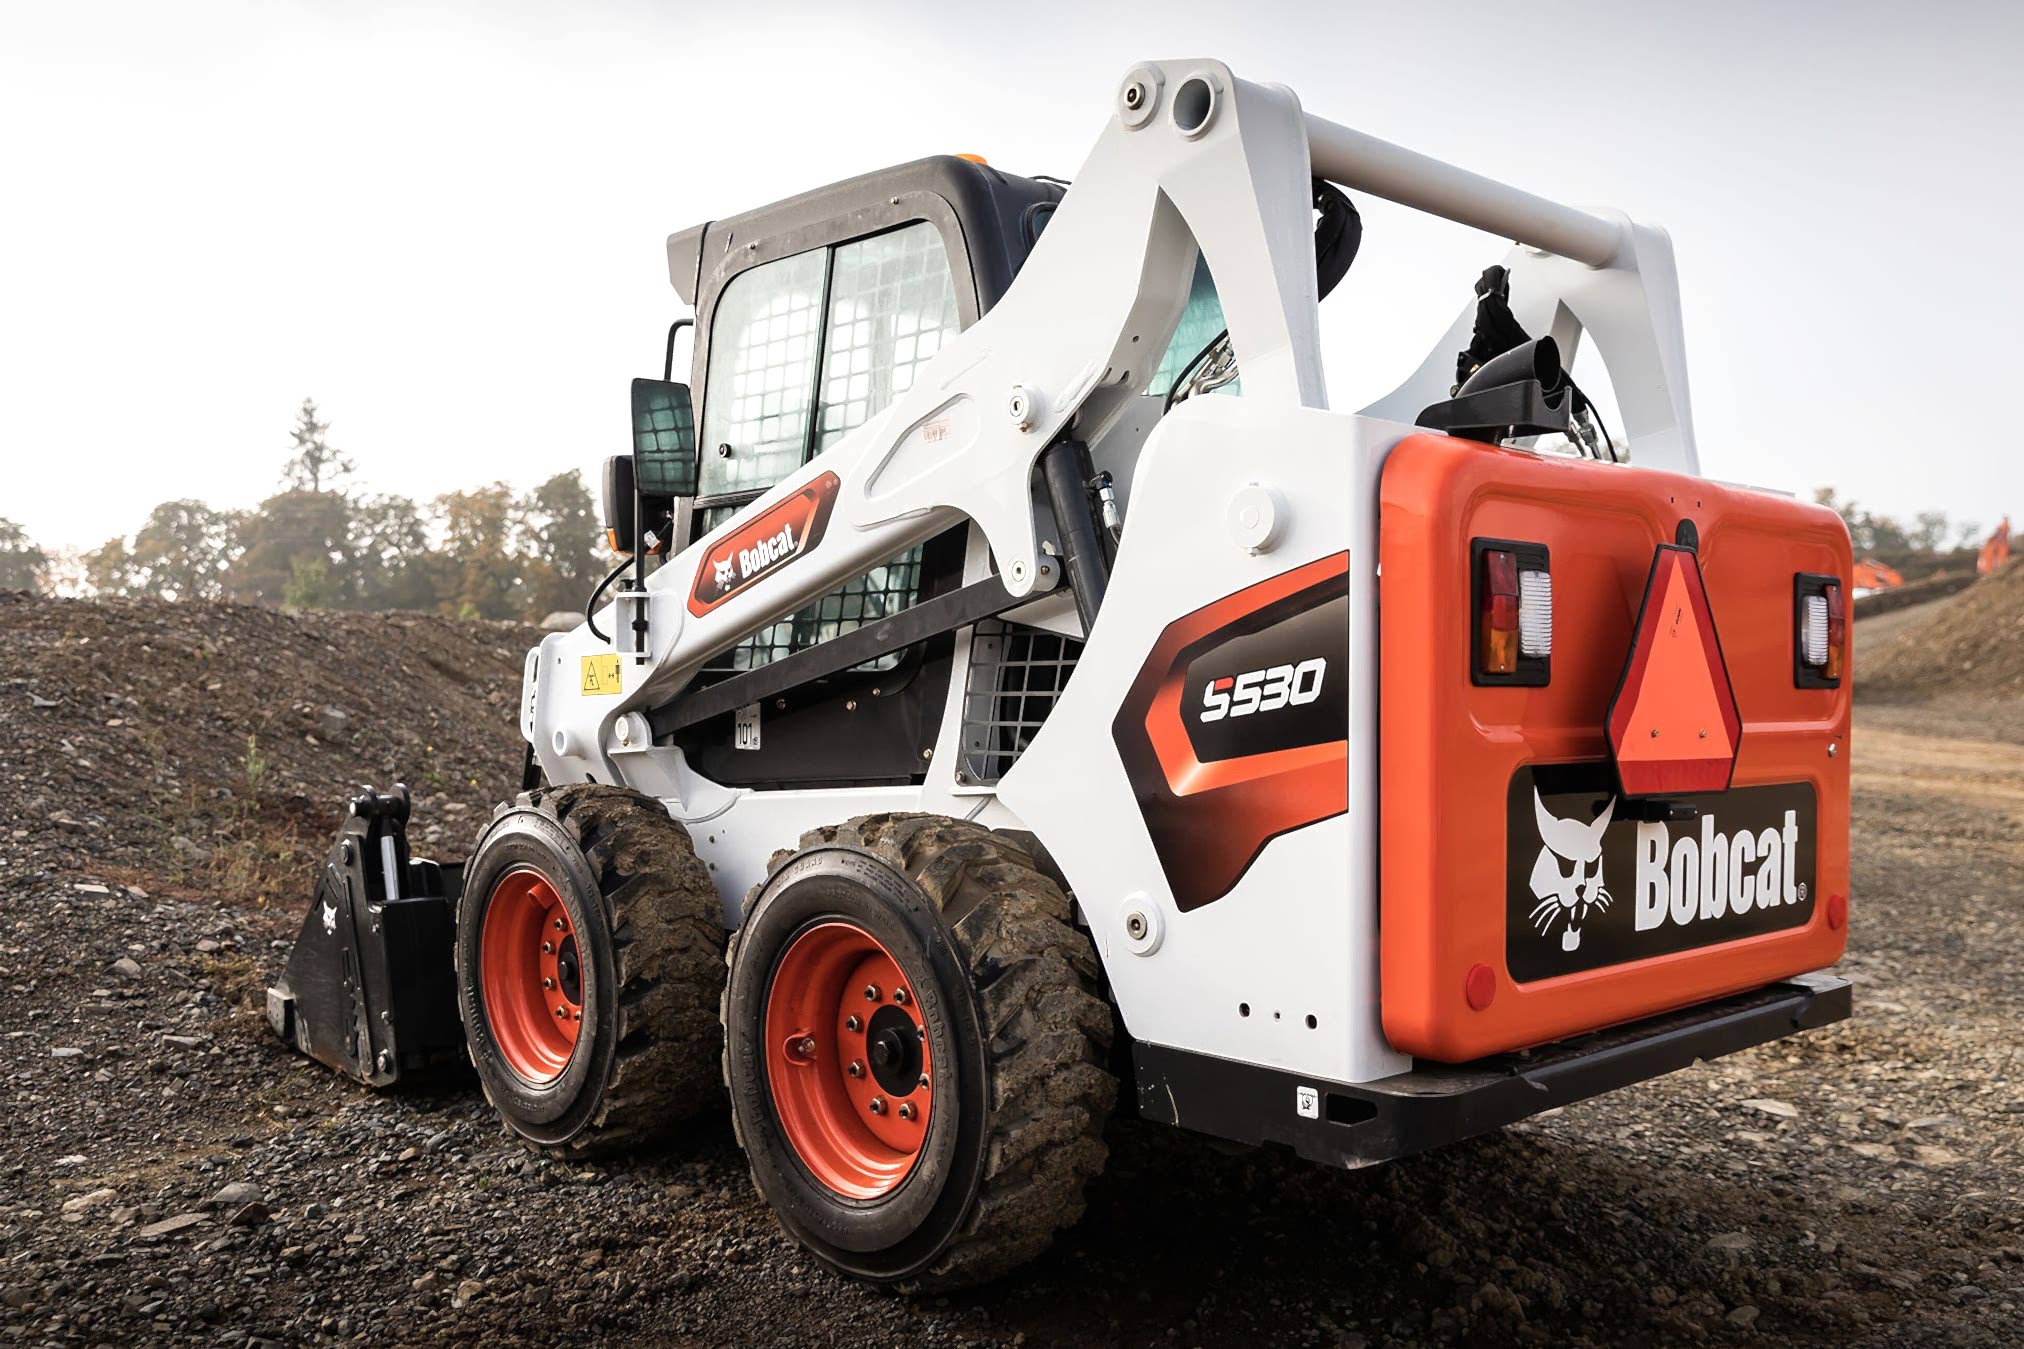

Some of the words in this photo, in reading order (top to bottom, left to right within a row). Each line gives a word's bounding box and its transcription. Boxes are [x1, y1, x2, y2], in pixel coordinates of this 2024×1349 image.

[739, 523, 795, 579] Bobcat
[1200, 657, 1327, 723] S530
[1635, 810, 1798, 932] Bobcat
